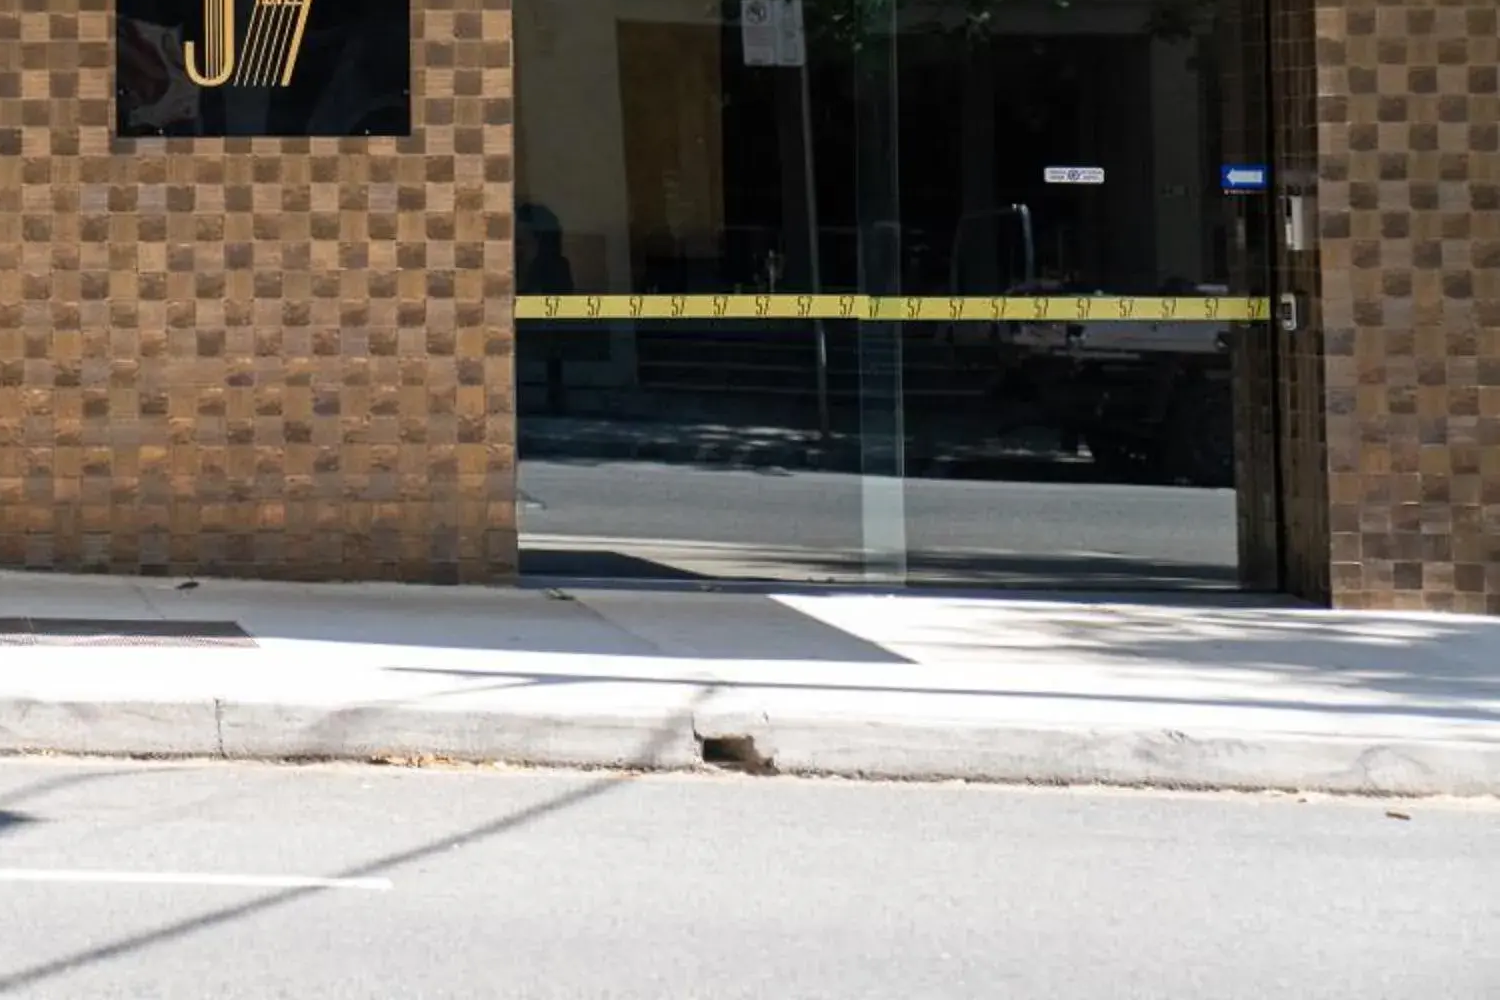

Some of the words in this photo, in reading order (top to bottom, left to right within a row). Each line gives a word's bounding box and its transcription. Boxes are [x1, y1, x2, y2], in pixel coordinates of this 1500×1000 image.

[545, 296, 561, 317] 57
[587, 296, 601, 317] 57
[629, 296, 644, 317] 57
[671, 296, 686, 317] 57
[713, 296, 729, 317] 57
[755, 296, 771, 317] 57
[797, 296, 813, 317] 57
[839, 296, 855, 317] 57
